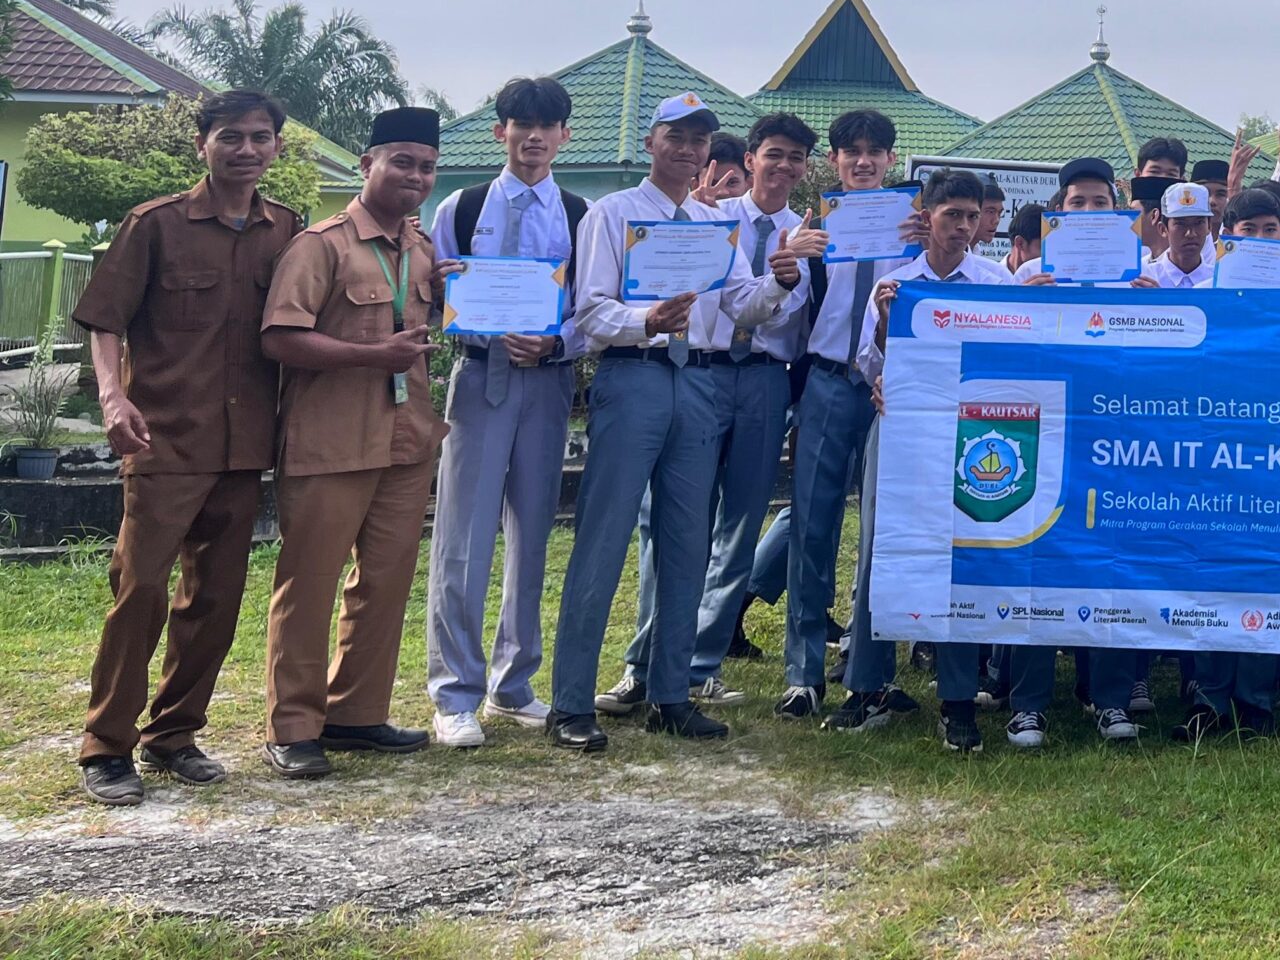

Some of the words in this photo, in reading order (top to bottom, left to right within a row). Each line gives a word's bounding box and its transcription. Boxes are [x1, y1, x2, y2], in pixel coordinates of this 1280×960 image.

[1040, 176, 1057, 186] DURI
[953, 312, 1031, 326] NYALANESIA
[1109, 317, 1136, 326] GSMB
[1138, 318, 1185, 327] NASIONAL
[1092, 394, 1189, 416] Selamat
[981, 406, 1036, 418] KAUTSAR
[1091, 439, 1163, 467] SMA
[1173, 441, 1203, 468] IT
[1102, 491, 1180, 511] Sekolah
[1186, 493, 1233, 512] Aktif
[1100, 519, 1124, 528] Mitra
[1126, 520, 1166, 531] Program
[1168, 521, 1208, 531] Gerakan
[1210, 521, 1248, 532] Sekolah
[957, 612, 986, 620] Nasional
[1012, 607, 1029, 616] SPL
[1030, 607, 1064, 617] Nasional
[1094, 607, 1131, 617] Penggerak
[1172, 608, 1218, 618] Akademisi
[1266, 611, 1280, 621] Adi
[1093, 616, 1120, 624] Literasi
[1121, 617, 1147, 625] Daerah
[1171, 617, 1205, 627] Menulis
[1206, 618, 1229, 628] Buku
